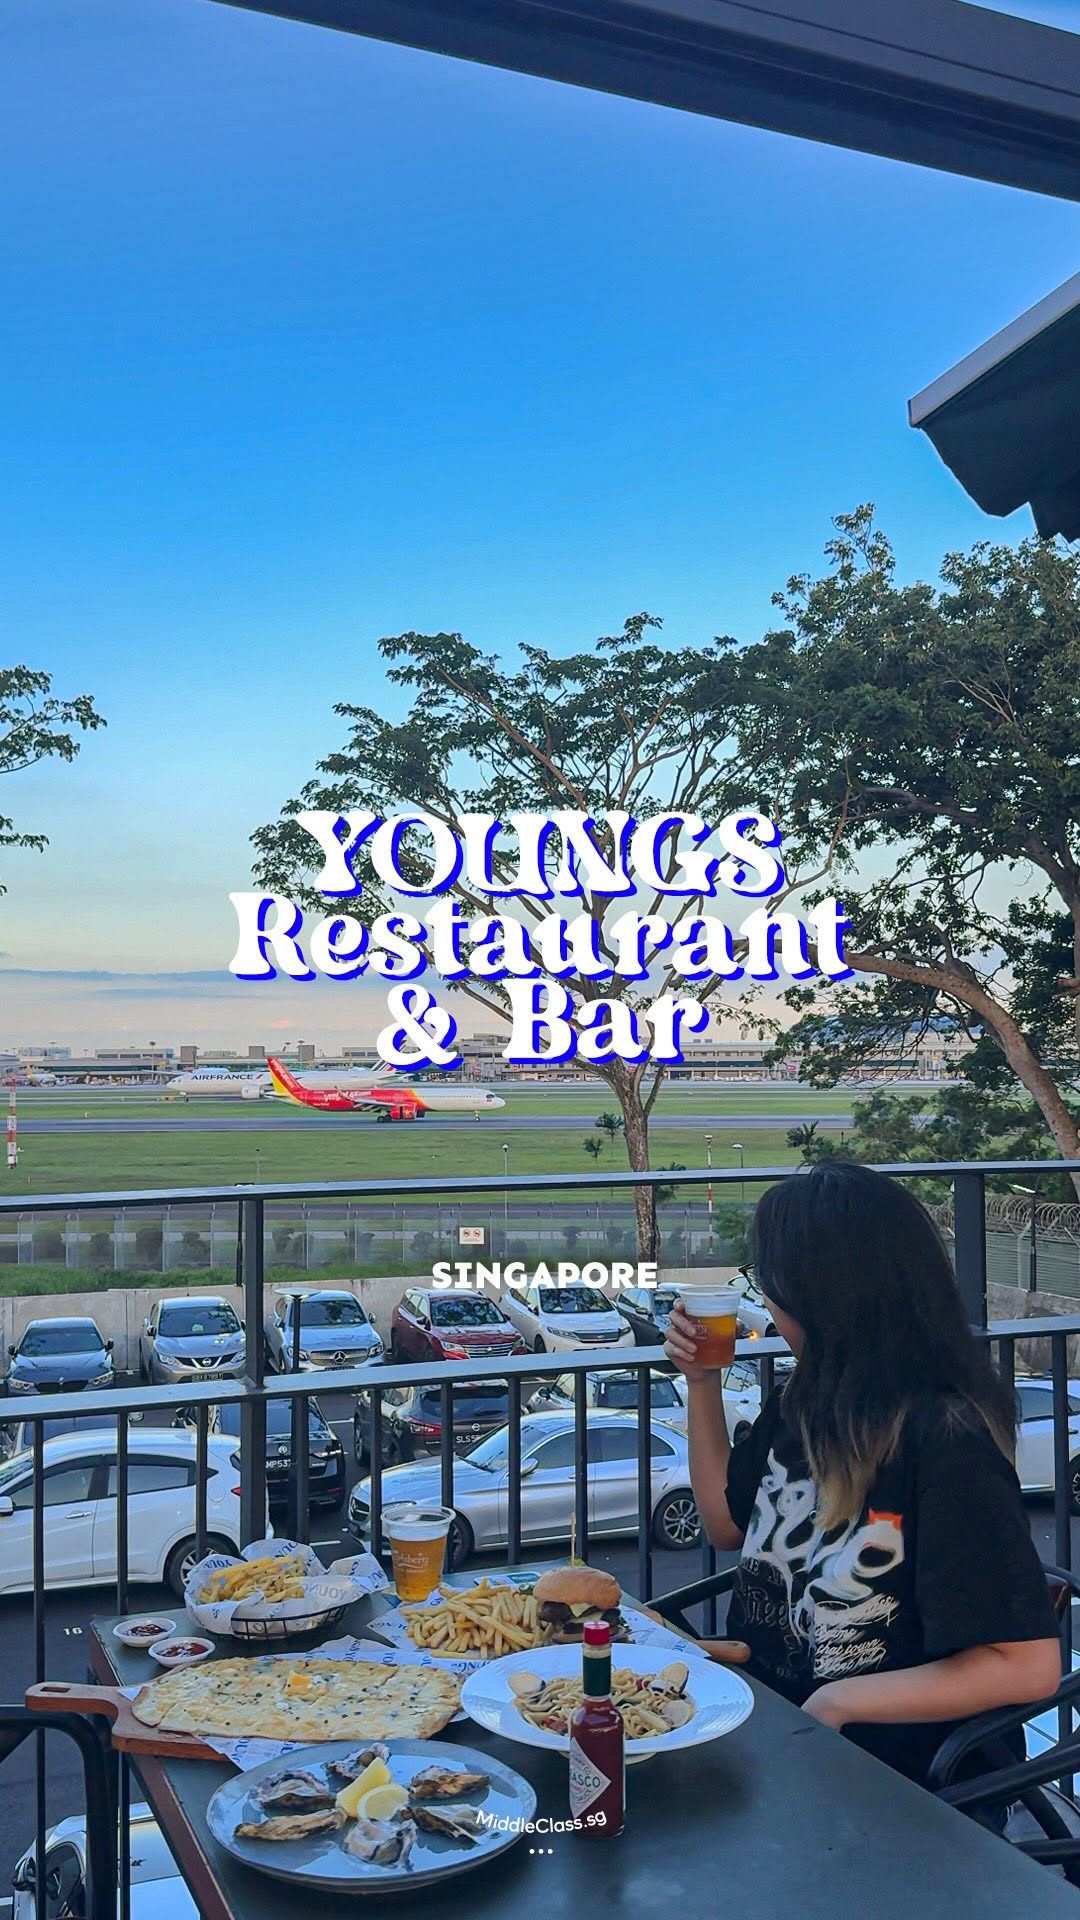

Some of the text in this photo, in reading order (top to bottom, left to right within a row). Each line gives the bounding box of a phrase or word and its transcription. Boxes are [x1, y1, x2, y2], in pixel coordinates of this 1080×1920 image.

[191, 1073, 253, 1081] AIRFRANCE
[63, 1627, 83, 1636] 16
[569, 1770, 601, 1789] ASCO
